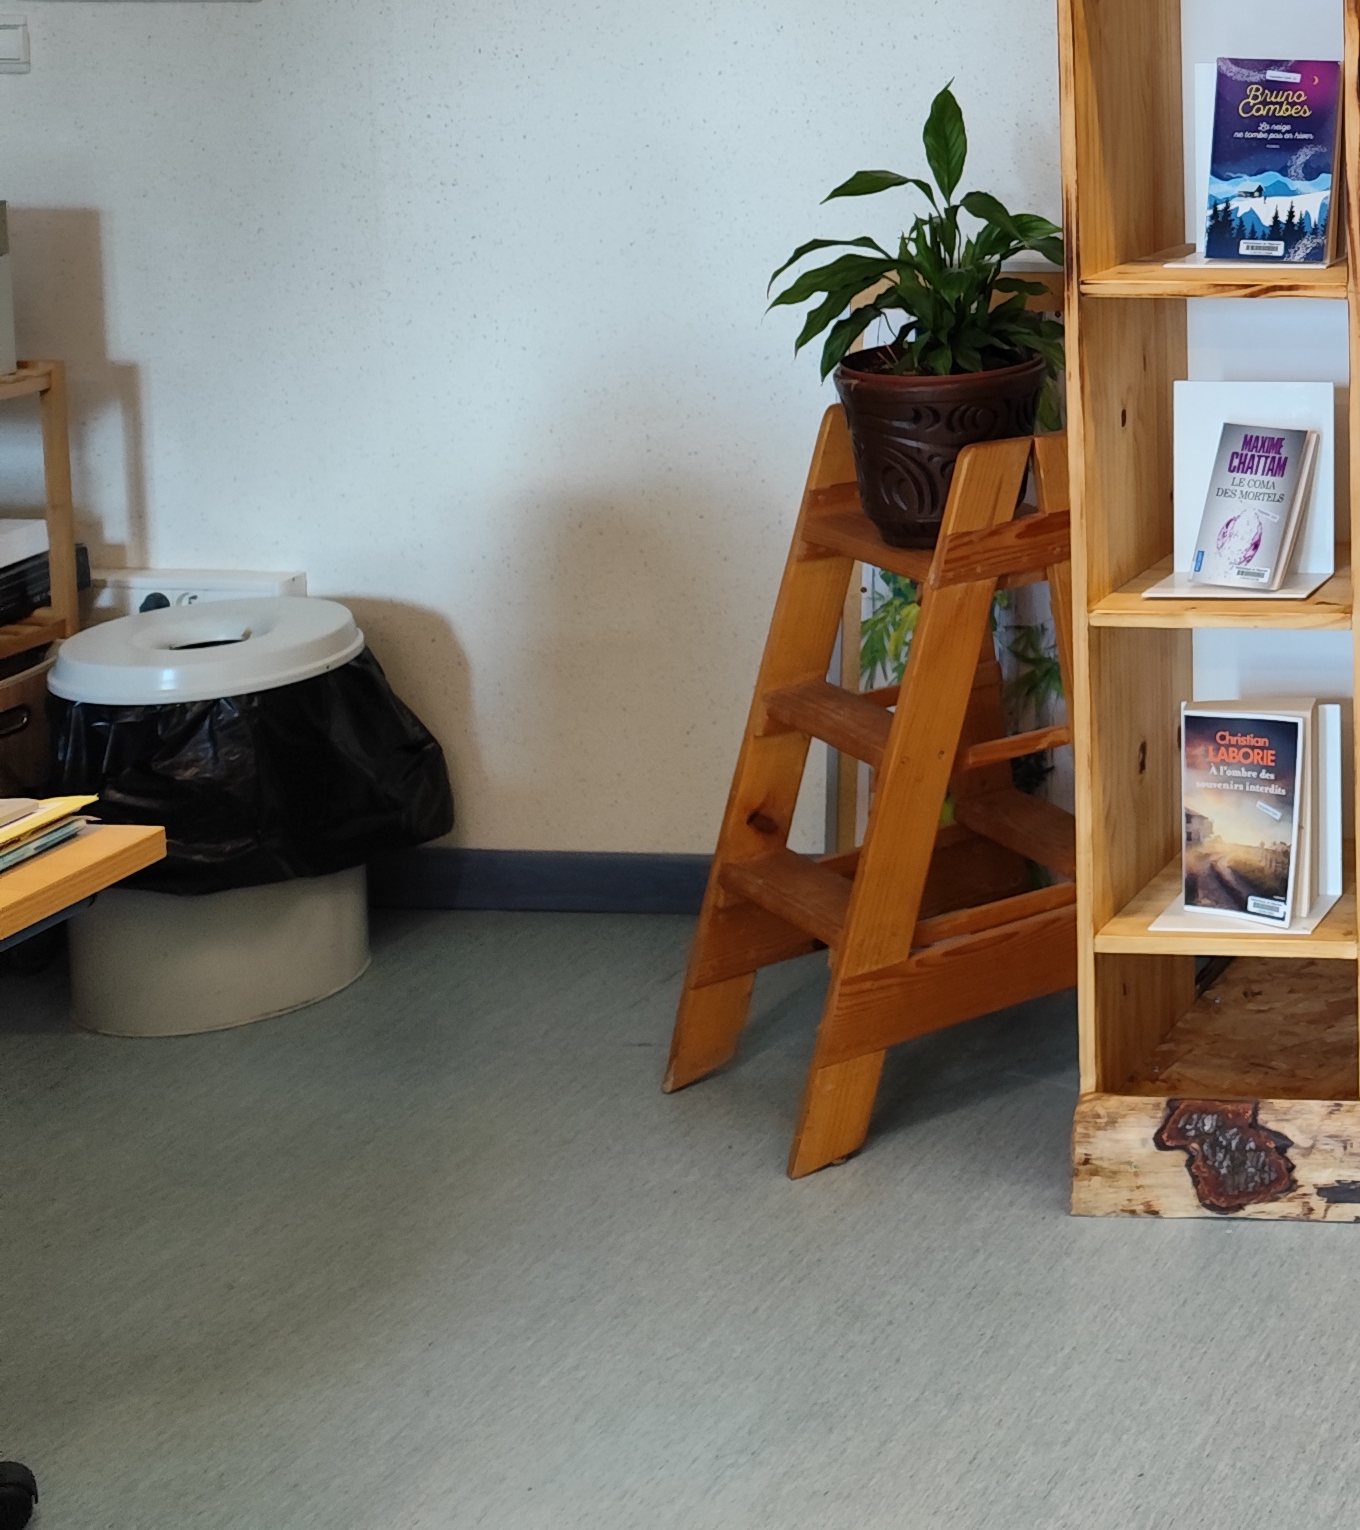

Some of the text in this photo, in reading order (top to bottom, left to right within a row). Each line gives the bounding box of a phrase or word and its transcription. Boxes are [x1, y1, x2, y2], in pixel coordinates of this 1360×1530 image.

[1246, 84, 1307, 103] Bruno
[1238, 99, 1312, 118] Combes
[1258, 121, 1291, 133] La neige
[1244, 131, 1267, 139] tombe
[1268, 133, 1283, 141] pas
[1241, 434, 1285, 456] MAXIME
[1227, 451, 1288, 478] CHATTAM
[1231, 477, 1276, 491] LE COMA
[1216, 487, 1285, 503] DES MORTELS
[1215, 730, 1269, 748] Christian
[1208, 746, 1276, 766] LABORIE
[1209, 763, 1276, 780] À l'ombre des
[1195, 780, 1286, 796] souvenirs interdits
